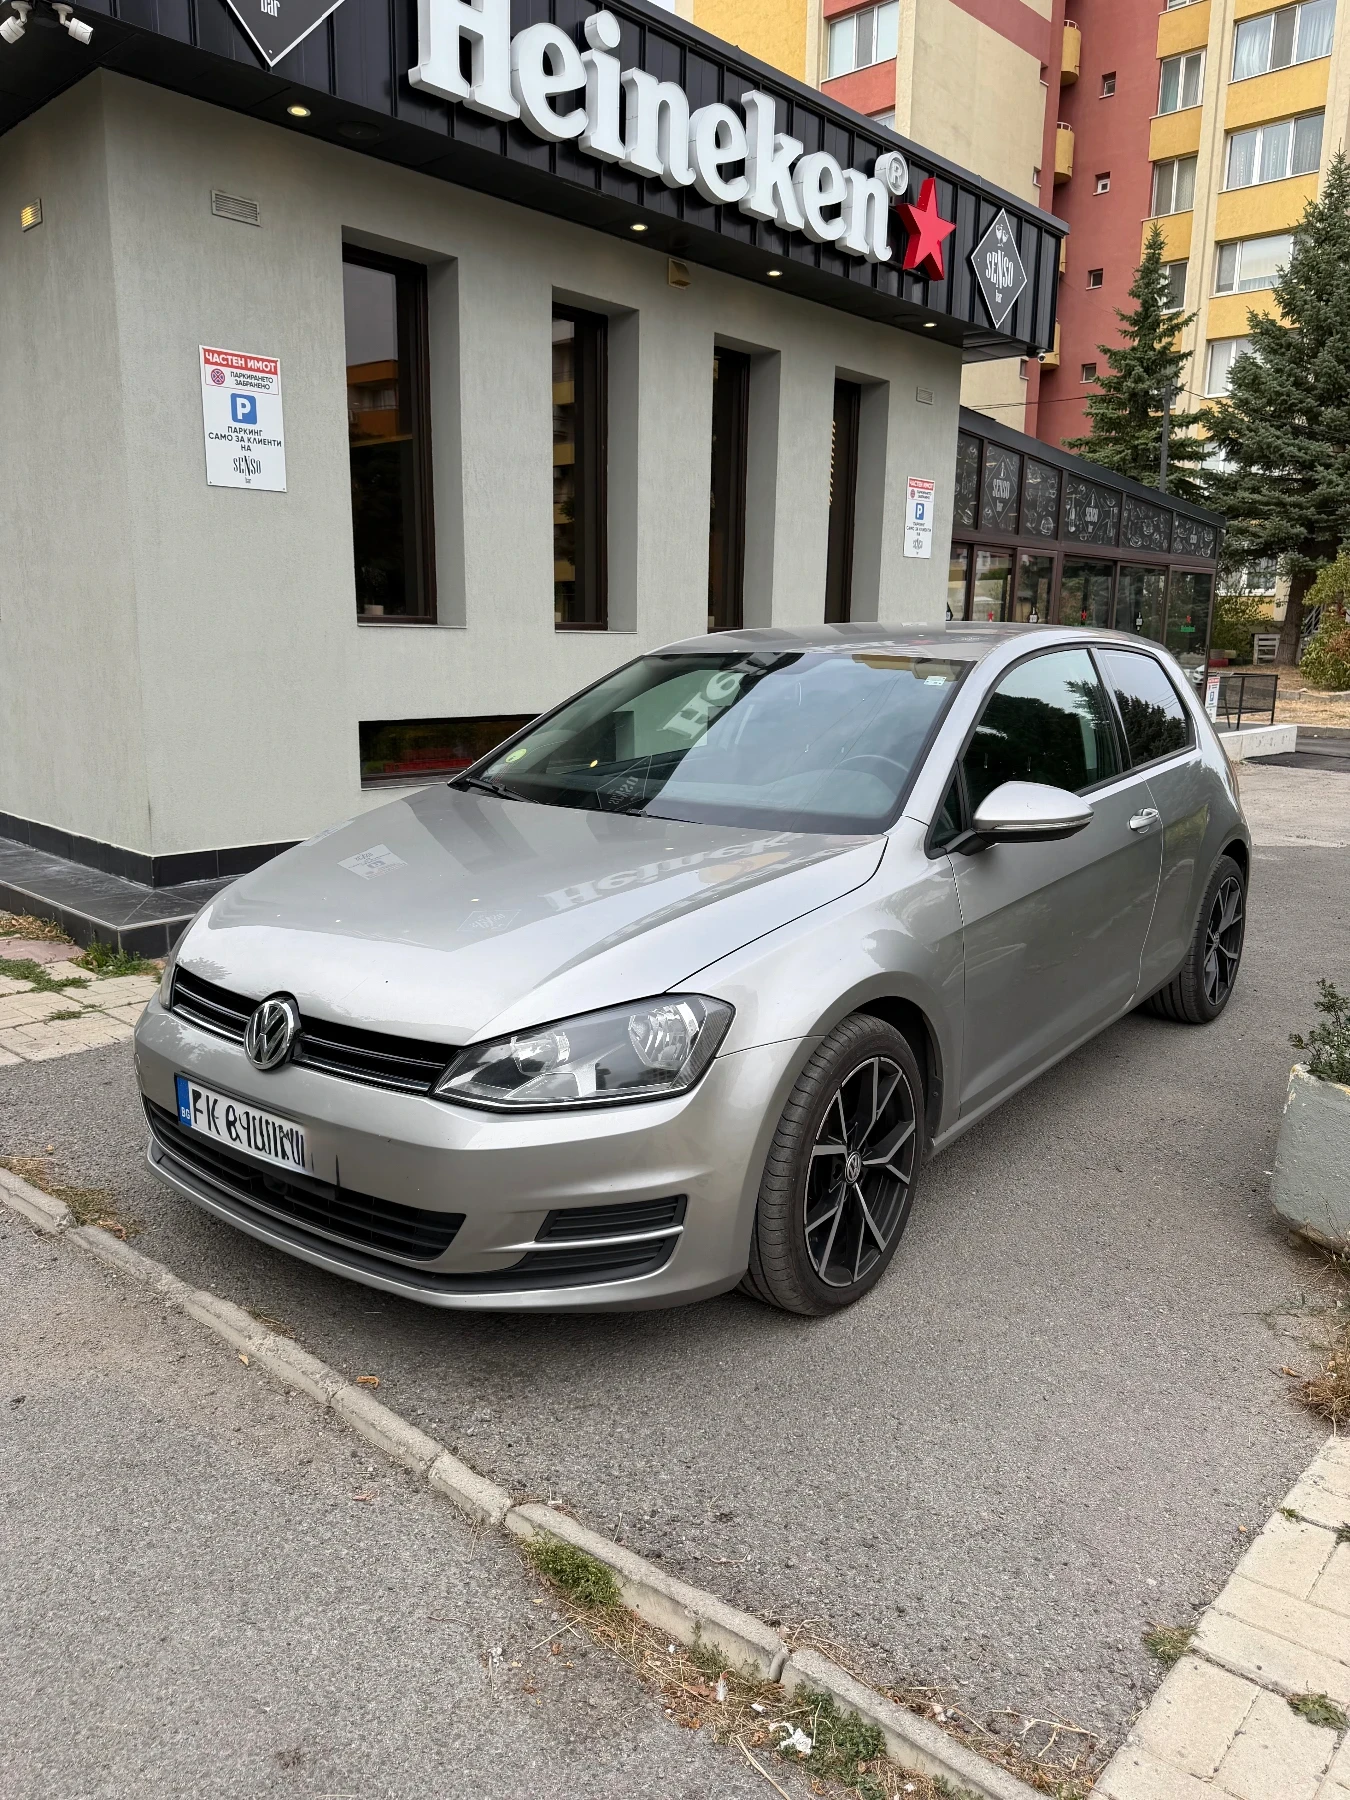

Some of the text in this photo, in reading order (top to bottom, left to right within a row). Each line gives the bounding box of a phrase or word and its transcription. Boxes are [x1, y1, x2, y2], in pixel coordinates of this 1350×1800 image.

[986, 249, 1014, 289] SENSO
[205, 351, 276, 372] ЧАСТЕН ИМОТ
[230, 371, 274, 384] ПАРКИРАНЕТО
[234, 379, 271, 390] ЗАБРАНЕНО
[227, 425, 263, 437] ПАРКИНГ
[208, 432, 282, 447] САМО ЗА КЛИЕНТИ
[240, 444, 252, 452] НА
[233, 455, 262, 476] SENSO
[181, 1106, 190, 1119] BG
